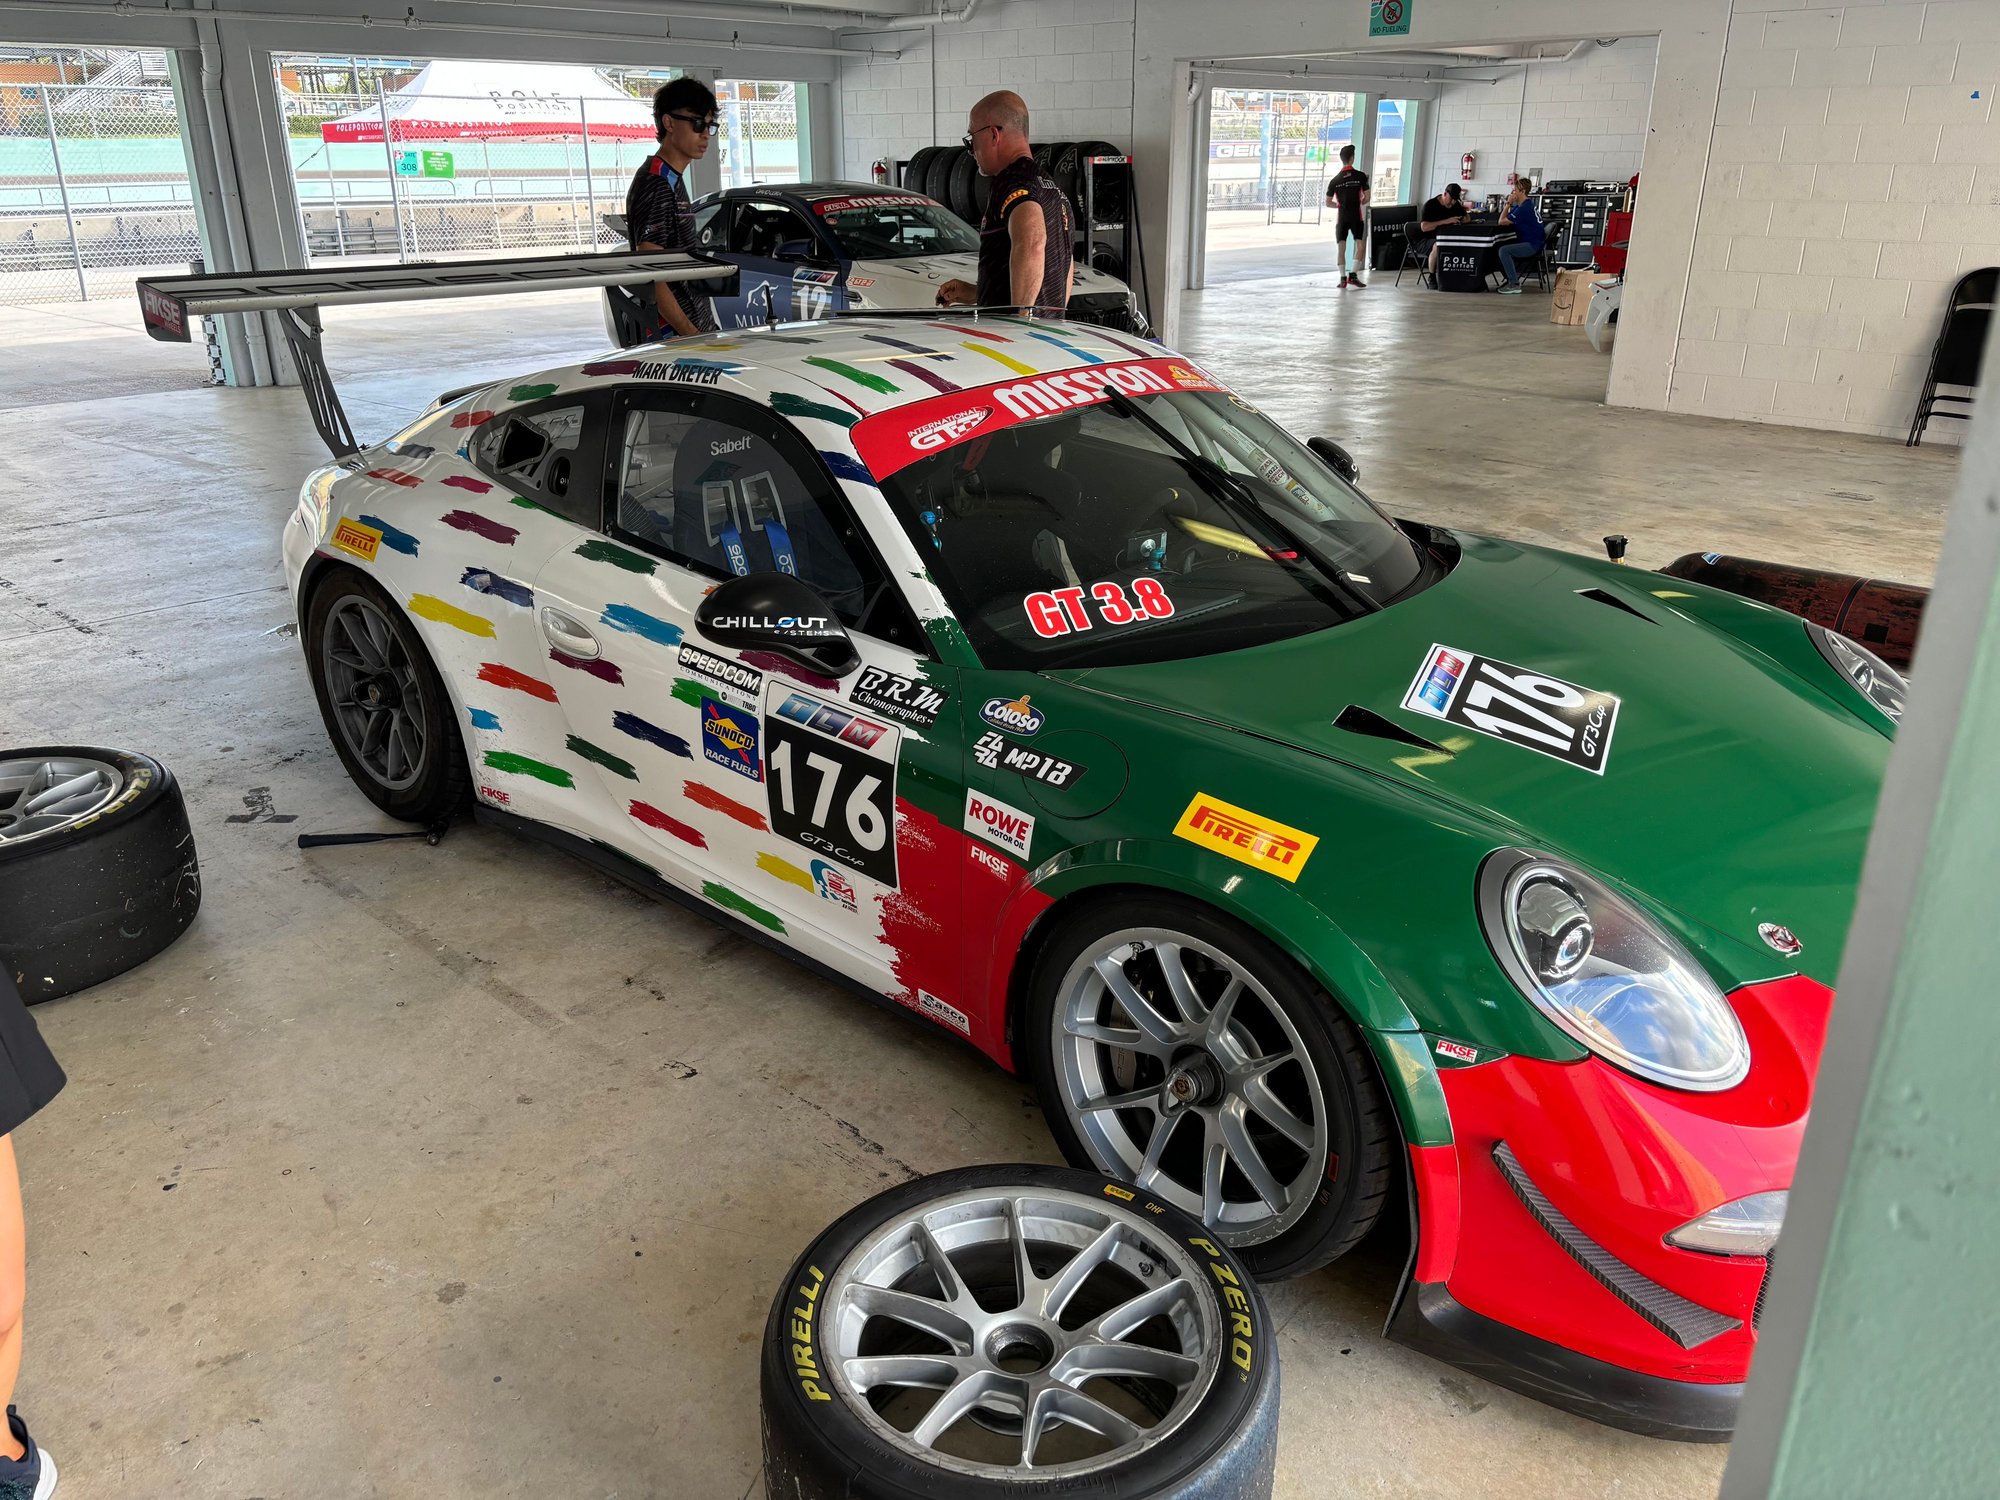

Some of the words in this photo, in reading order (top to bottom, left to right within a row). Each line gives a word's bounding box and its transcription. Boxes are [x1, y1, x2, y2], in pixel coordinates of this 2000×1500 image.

[1372, 26, 1380, 34] NO
[1382, 24, 1408, 33] FUELING
[401, 163, 418, 172] 308
[1443, 256, 1475, 265] POLE
[144, 290, 181, 326] FIKSE
[797, 284, 829, 321] 12
[632, 360, 671, 380] MARK
[669, 363, 723, 385] DREYER
[993, 366, 1174, 419] MISSION
[908, 406, 979, 438] INTERNATIONAL
[710, 435, 752, 456] Sabelt
[336, 524, 376, 553] PIRELLI
[712, 616, 828, 629] CHILLOUT
[1023, 585, 1093, 639] GT
[1091, 577, 1175, 625] 3.8
[679, 647, 762, 692] SPEEDCOM
[680, 666, 757, 702] COMMUNICATIONS
[1422, 653, 1461, 708] TLM
[785, 696, 882, 748] TLM
[1461, 662, 1586, 752] 176
[706, 720, 754, 750] SUNOCO
[705, 747, 731, 766] RACE
[730, 759, 759, 779] FUELS
[480, 785, 511, 803] FIKSE
[770, 739, 887, 852] 176
[968, 797, 1030, 842] ROWE
[1188, 805, 1301, 865] PIRELLI
[987, 827, 1013, 845] MOTOR
[1013, 840, 1025, 851] OIL
[970, 845, 1009, 877] FIKSE
[1437, 1041, 1477, 1059] FIKSE
[1144, 1202, 1166, 1215] DHF
[1188, 1237, 1221, 1257] P
[1209, 1262, 1254, 1372] ZERO
[791, 1265, 832, 1401] PIRELLI
